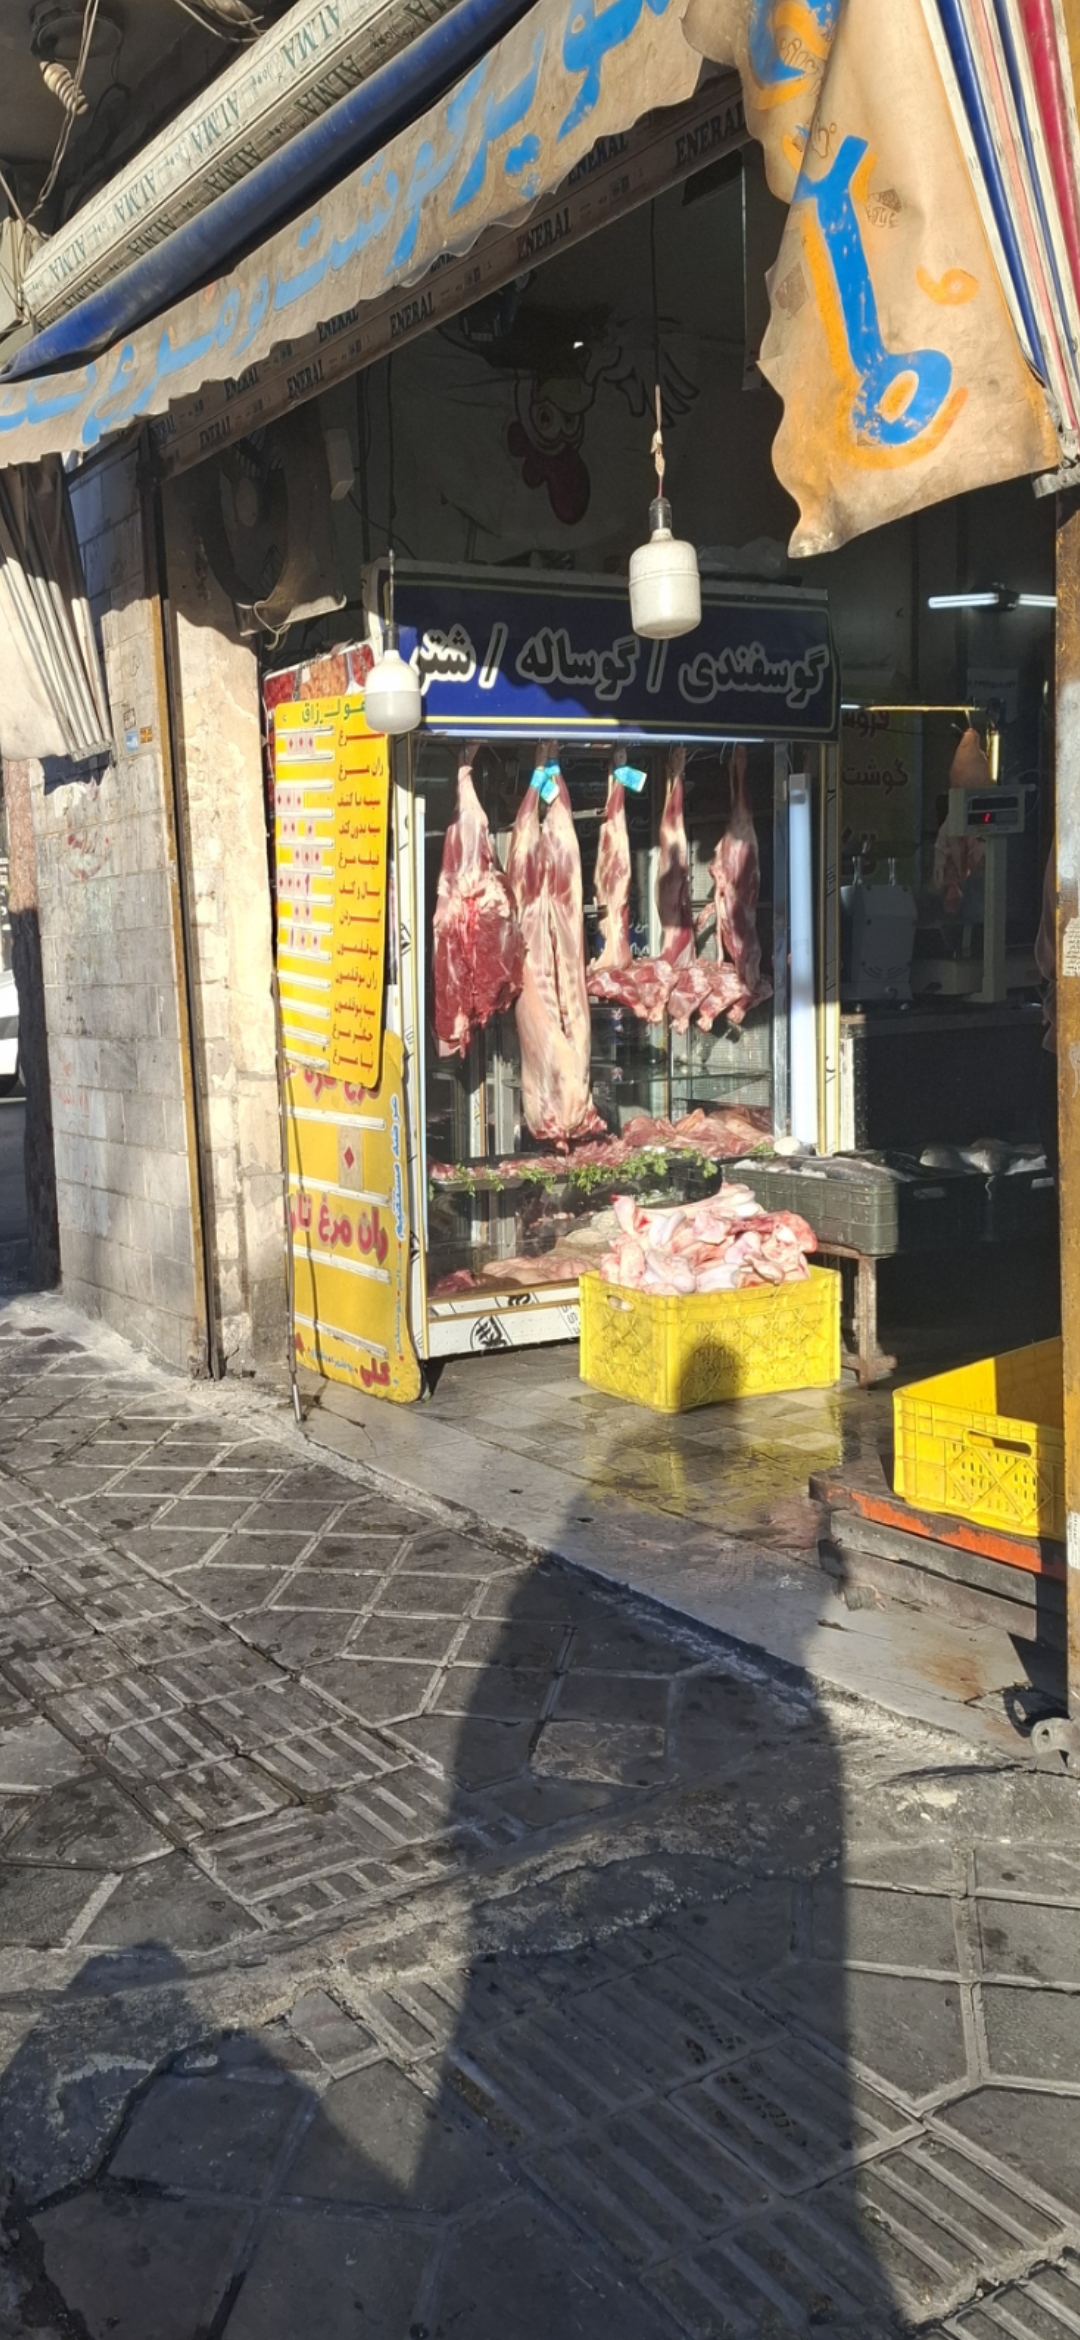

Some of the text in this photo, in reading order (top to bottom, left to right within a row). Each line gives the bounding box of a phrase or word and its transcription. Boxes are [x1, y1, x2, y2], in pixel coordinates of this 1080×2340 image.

[281, 2, 341, 70] ALMA
[294, 54, 365, 117] ALMA
[190, 91, 241, 153] ALMA
[203, 141, 263, 194] ALMA
[113, 168, 158, 224] ALMA
[49, 234, 88, 282] ALMA
[389, 290, 436, 337] ENERAL
[414, 624, 476, 693] شتر
[516, 628, 640, 700] گوساله
[679, 640, 829, 707] گوسفندی
[338, 756, 384, 782] ران مرغ
[842, 757, 909, 796] گوشت
[338, 848, 357, 869] مرغ
[332, 1022, 352, 1041] مرغ
[318, 1193, 354, 1249] مرغ
